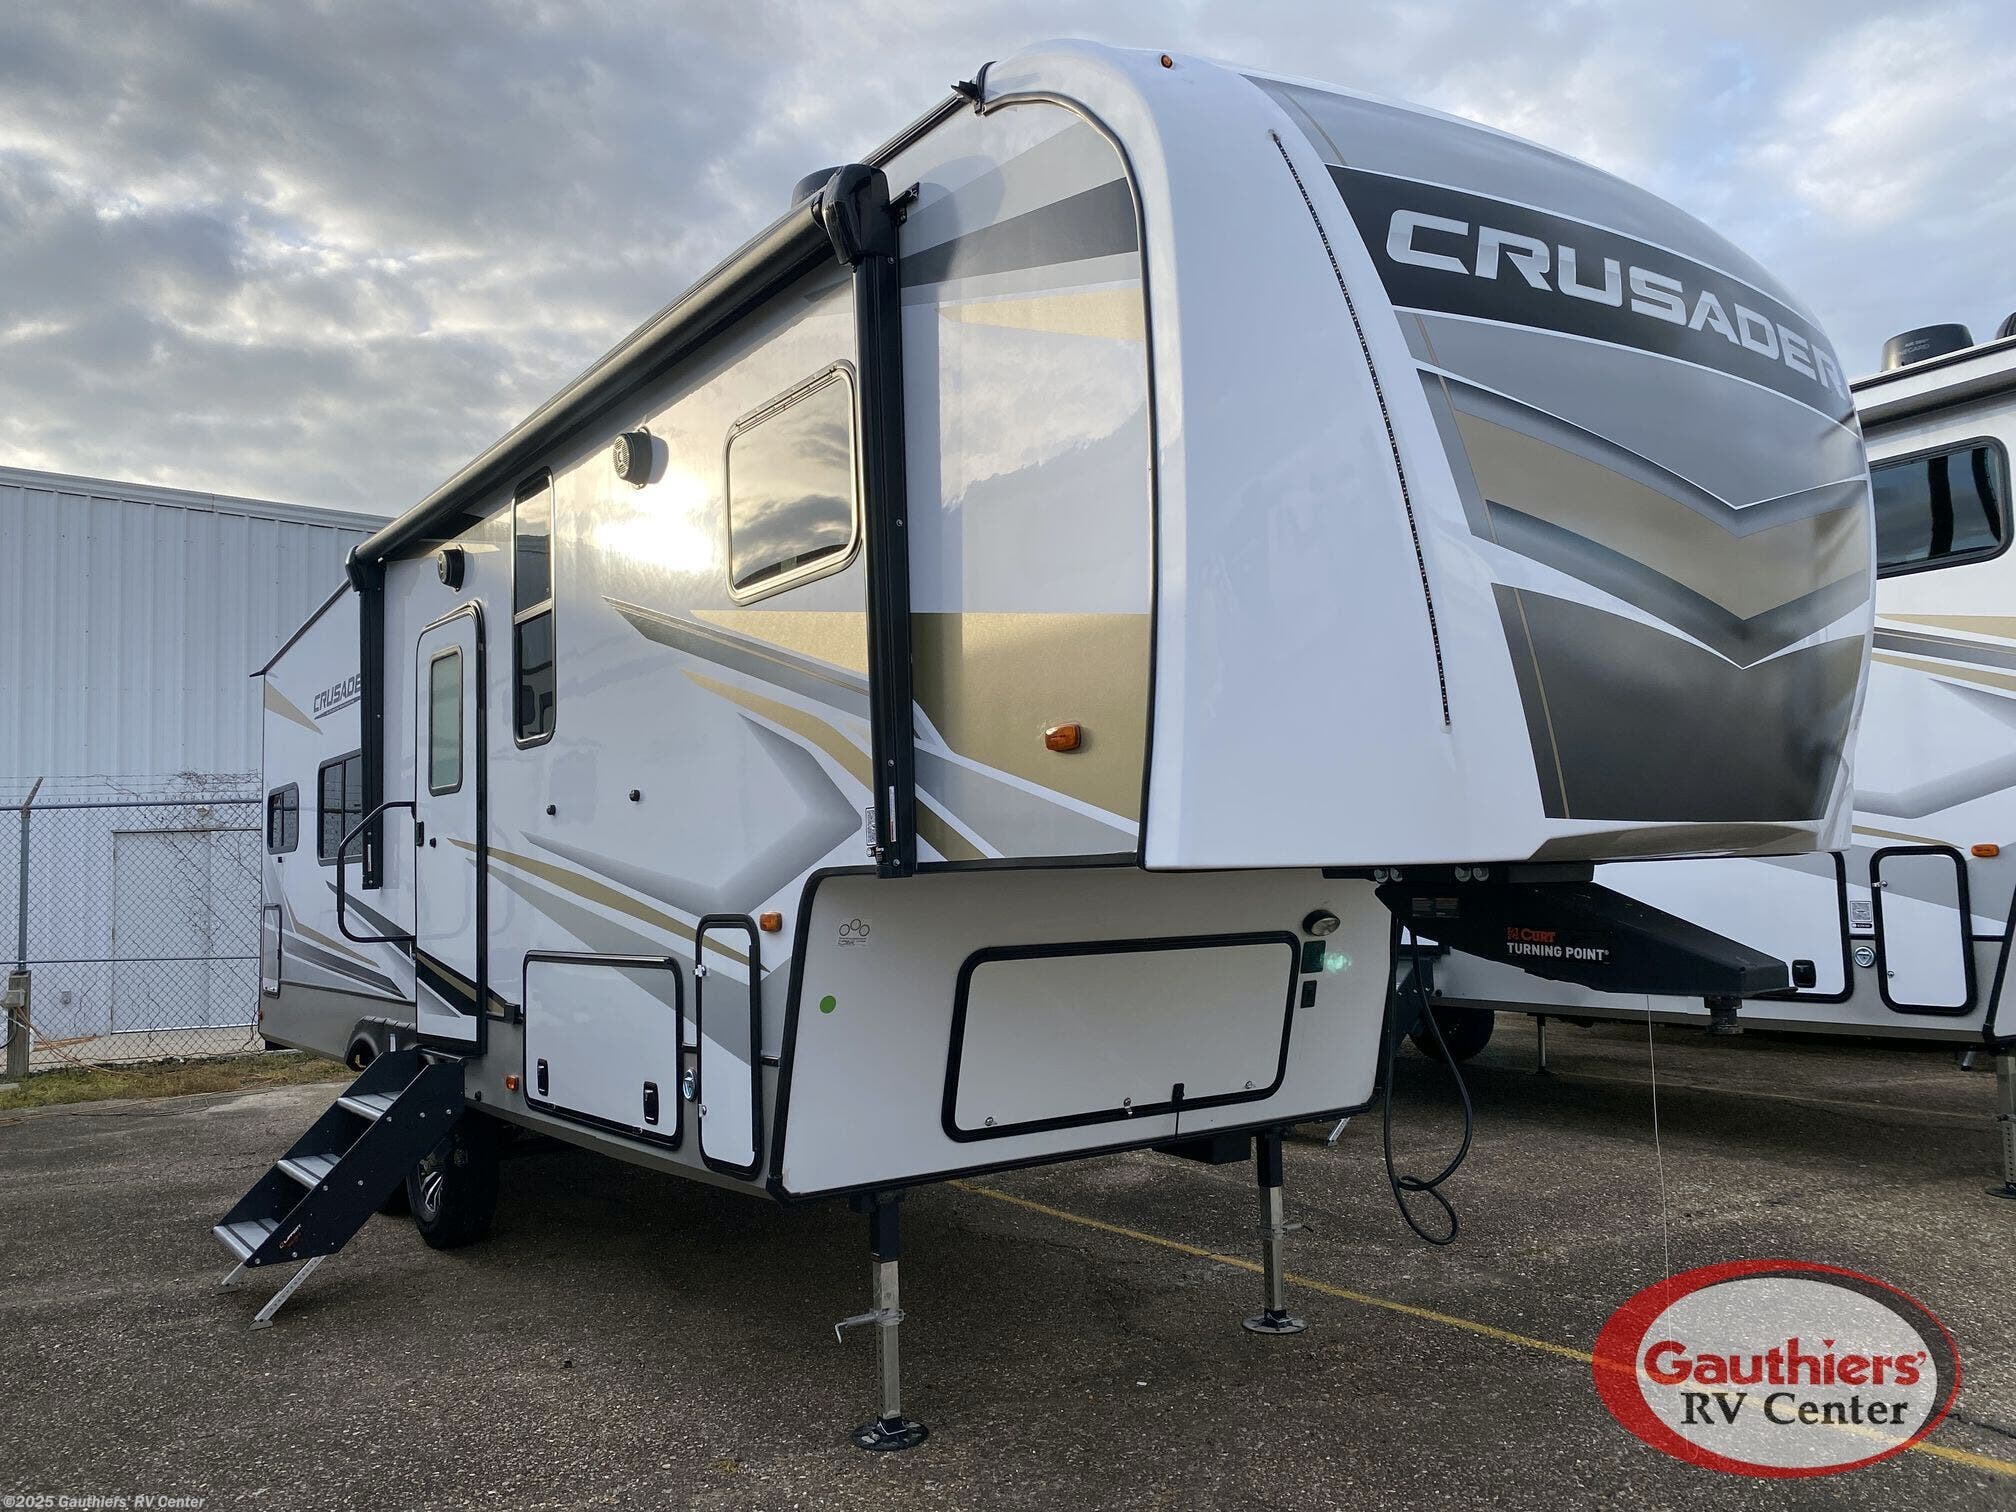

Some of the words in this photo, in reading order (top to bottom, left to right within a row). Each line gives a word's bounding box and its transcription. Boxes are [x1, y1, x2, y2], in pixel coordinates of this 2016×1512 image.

[1386, 208, 1846, 401] CRUSADER
[1521, 928, 1556, 943] CURT
[1506, 942, 1562, 958] TURNING
